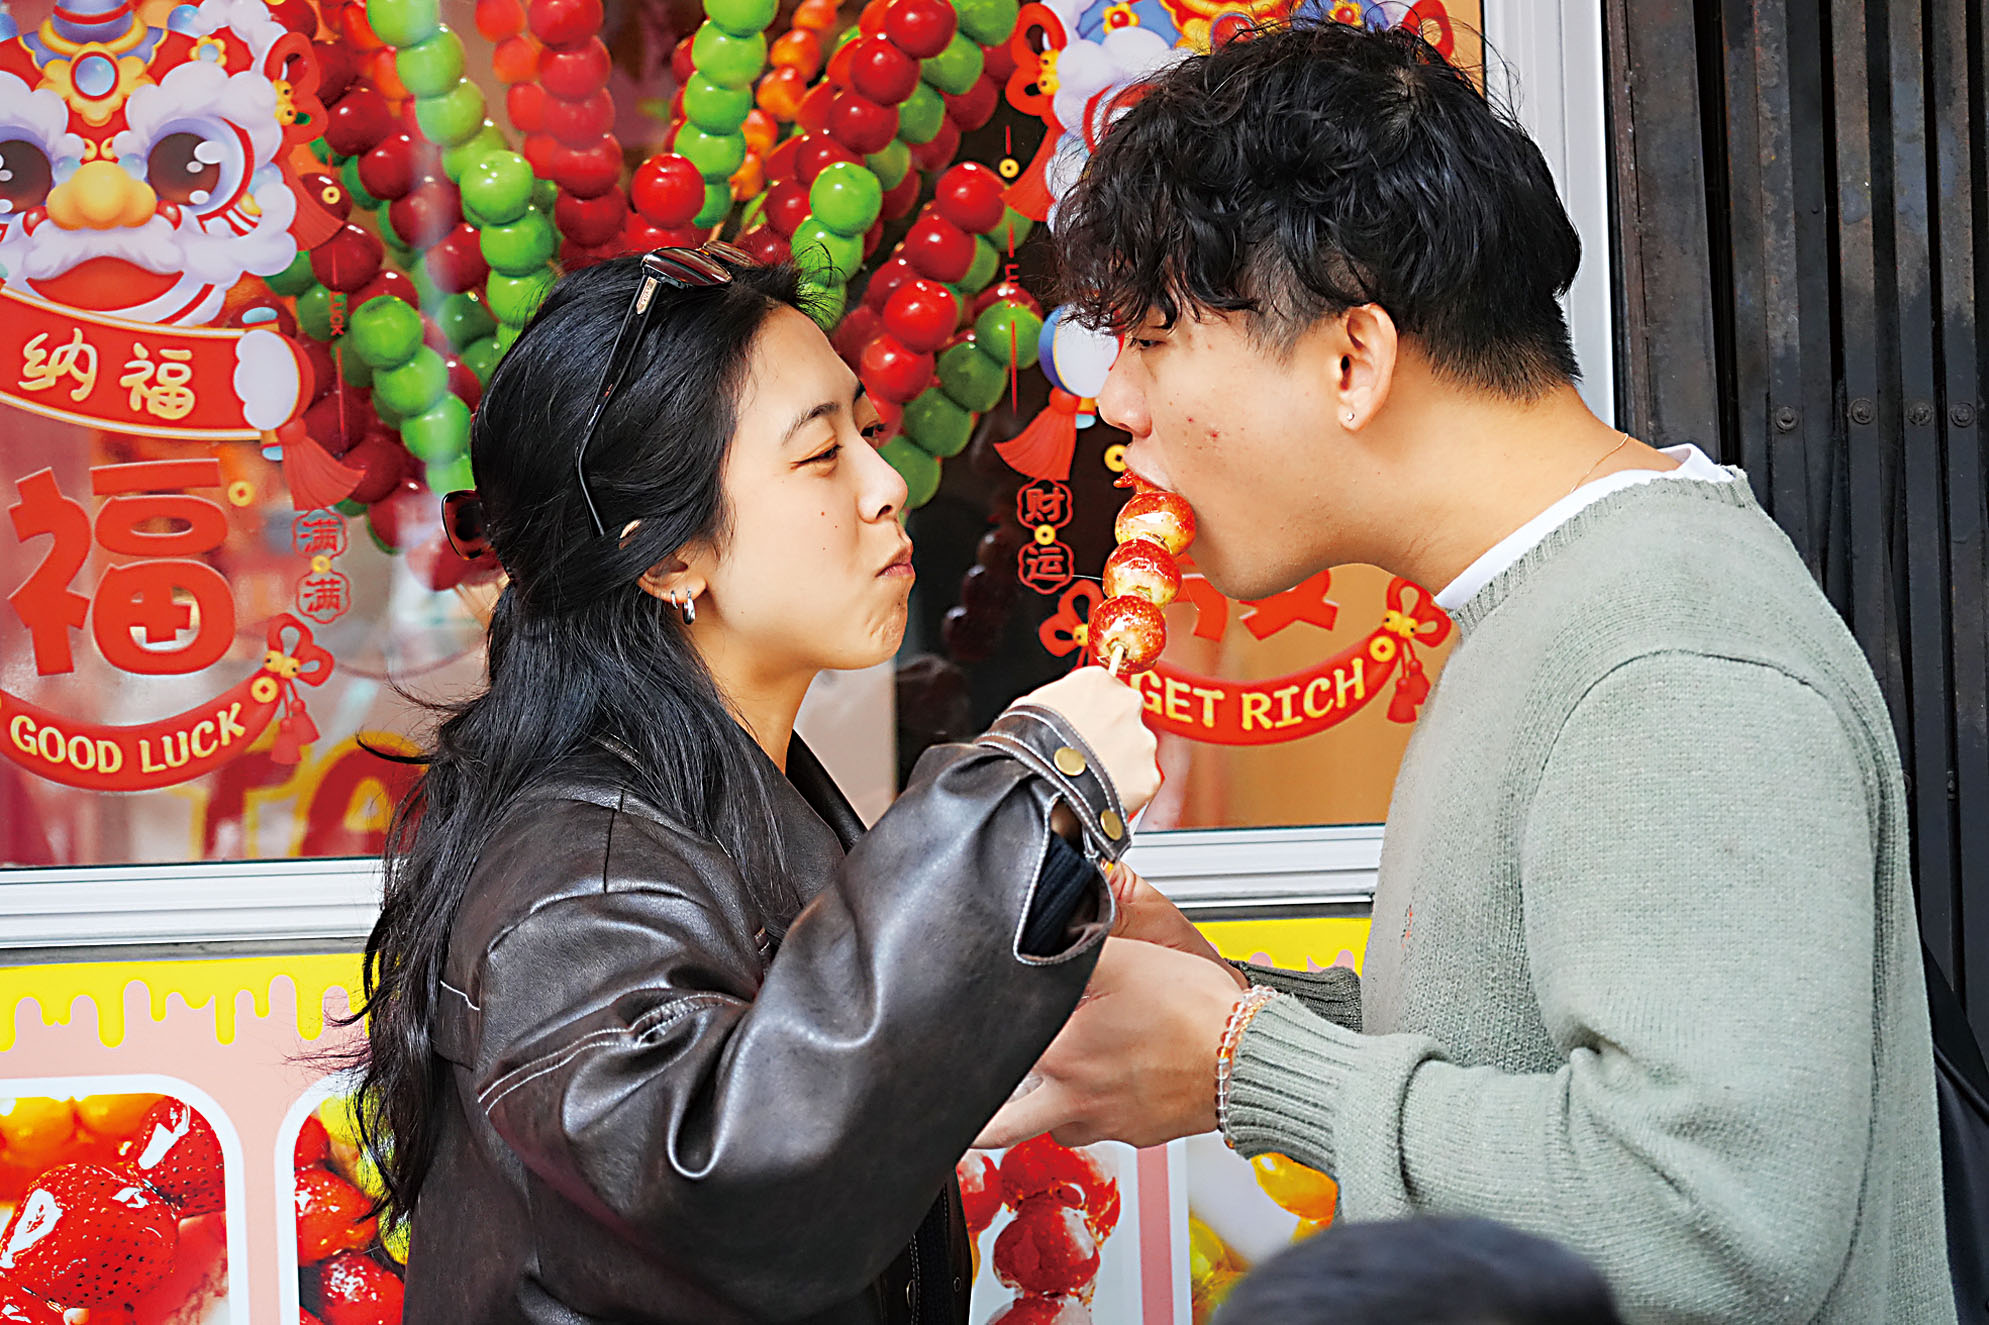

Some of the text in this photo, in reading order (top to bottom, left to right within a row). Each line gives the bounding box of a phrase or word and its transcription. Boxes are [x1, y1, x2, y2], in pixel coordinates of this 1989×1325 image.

[330, 291, 345, 336] LUCK
[18, 328, 195, 420] 纳福
[8, 459, 236, 677] 福
[300, 518, 341, 612] 满满
[1025, 487, 1067, 582] 财运
[10, 702, 246, 774] GOOD LUCK
[1129, 658, 1365, 731] GET RICH
